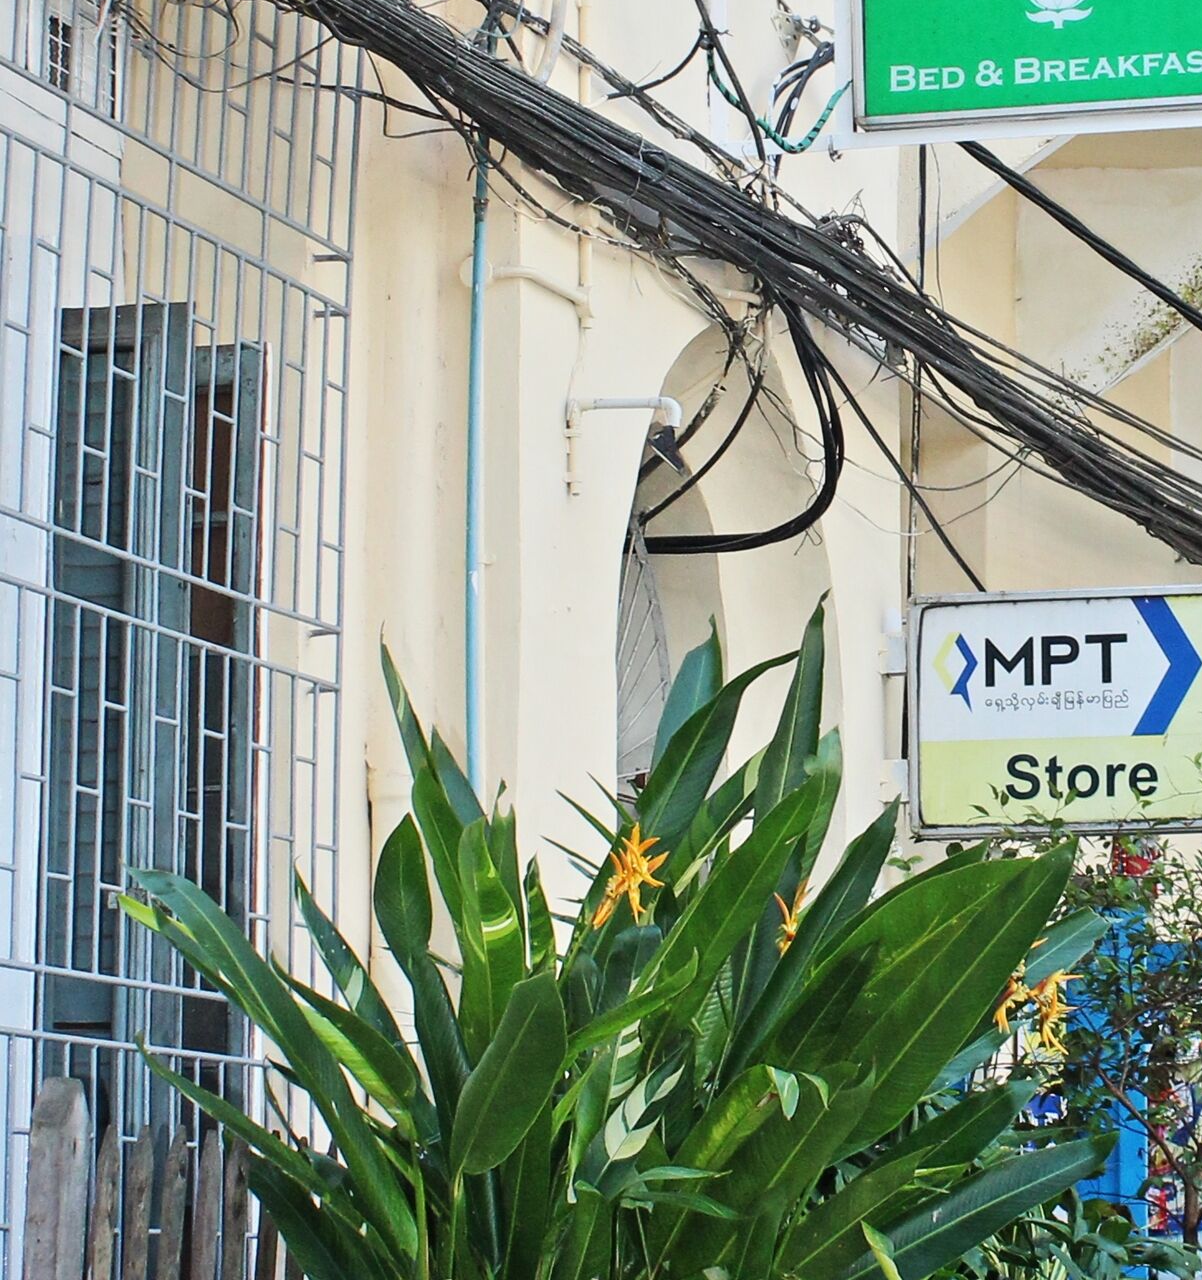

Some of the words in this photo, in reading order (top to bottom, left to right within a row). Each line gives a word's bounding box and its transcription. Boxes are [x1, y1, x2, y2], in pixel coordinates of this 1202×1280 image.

[975, 60, 1003, 87] &
[984, 633, 1128, 688] MPT
[1005, 753, 1158, 800] Store
